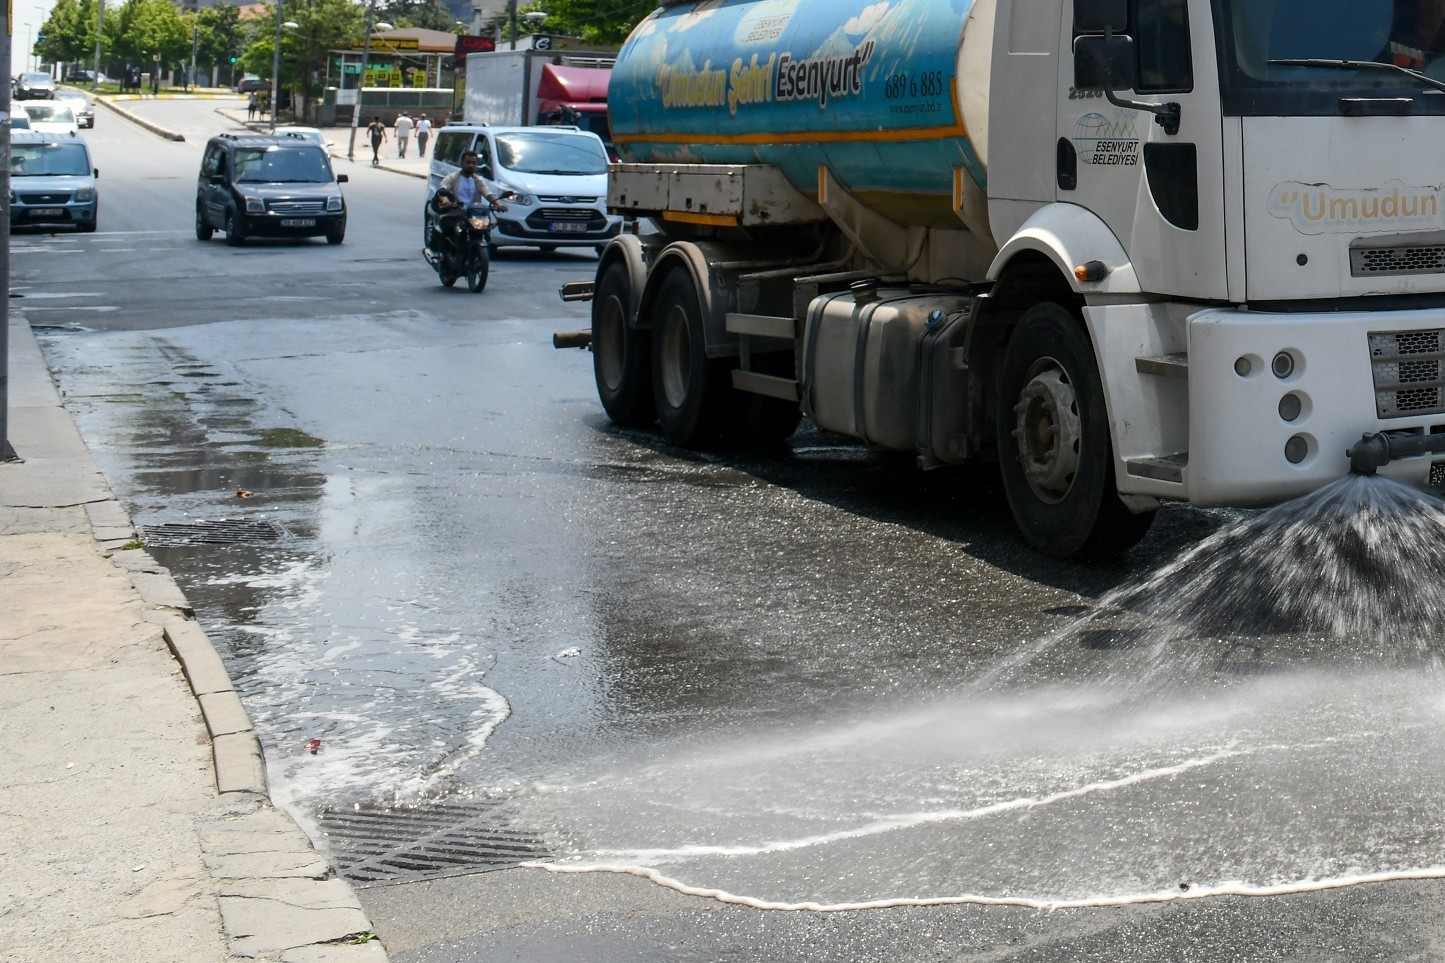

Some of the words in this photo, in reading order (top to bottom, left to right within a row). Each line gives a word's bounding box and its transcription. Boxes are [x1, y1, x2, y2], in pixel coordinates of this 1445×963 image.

[885, 74, 907, 99] 689
[910, 73, 918, 98] 6
[920, 71, 944, 97] 885
[889, 101, 943, 115] www.esenyurt.bel.tr
[1095, 141, 1139, 152] ESENYURT
[1092, 152, 1139, 165] BELEDİYESİ
[1280, 189, 1438, 221] "Umudun
